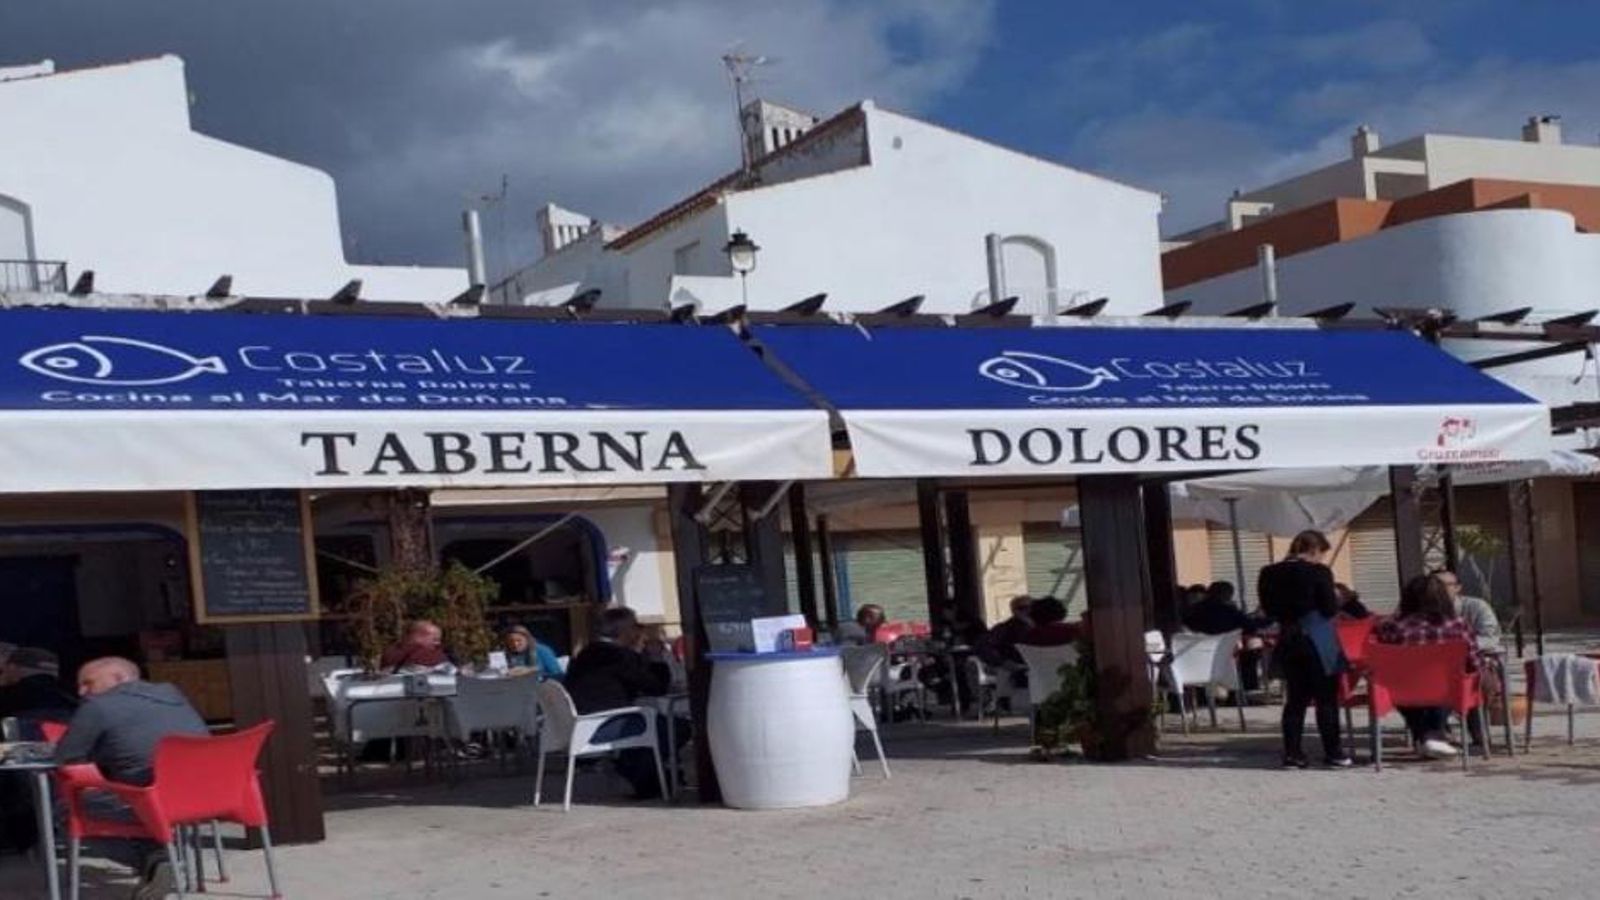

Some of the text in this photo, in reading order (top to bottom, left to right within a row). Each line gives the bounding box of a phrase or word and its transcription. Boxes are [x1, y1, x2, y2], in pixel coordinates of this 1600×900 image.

[238, 346, 536, 374] Costaluz
[1110, 357, 1321, 378] Costaluz
[40, 391, 192, 402] Cocina
[210, 392, 243, 402] al
[258, 393, 341, 403] Mar
[359, 394, 406, 403] de
[301, 431, 706, 475] TABERNA
[966, 424, 1261, 466] DOLORES
